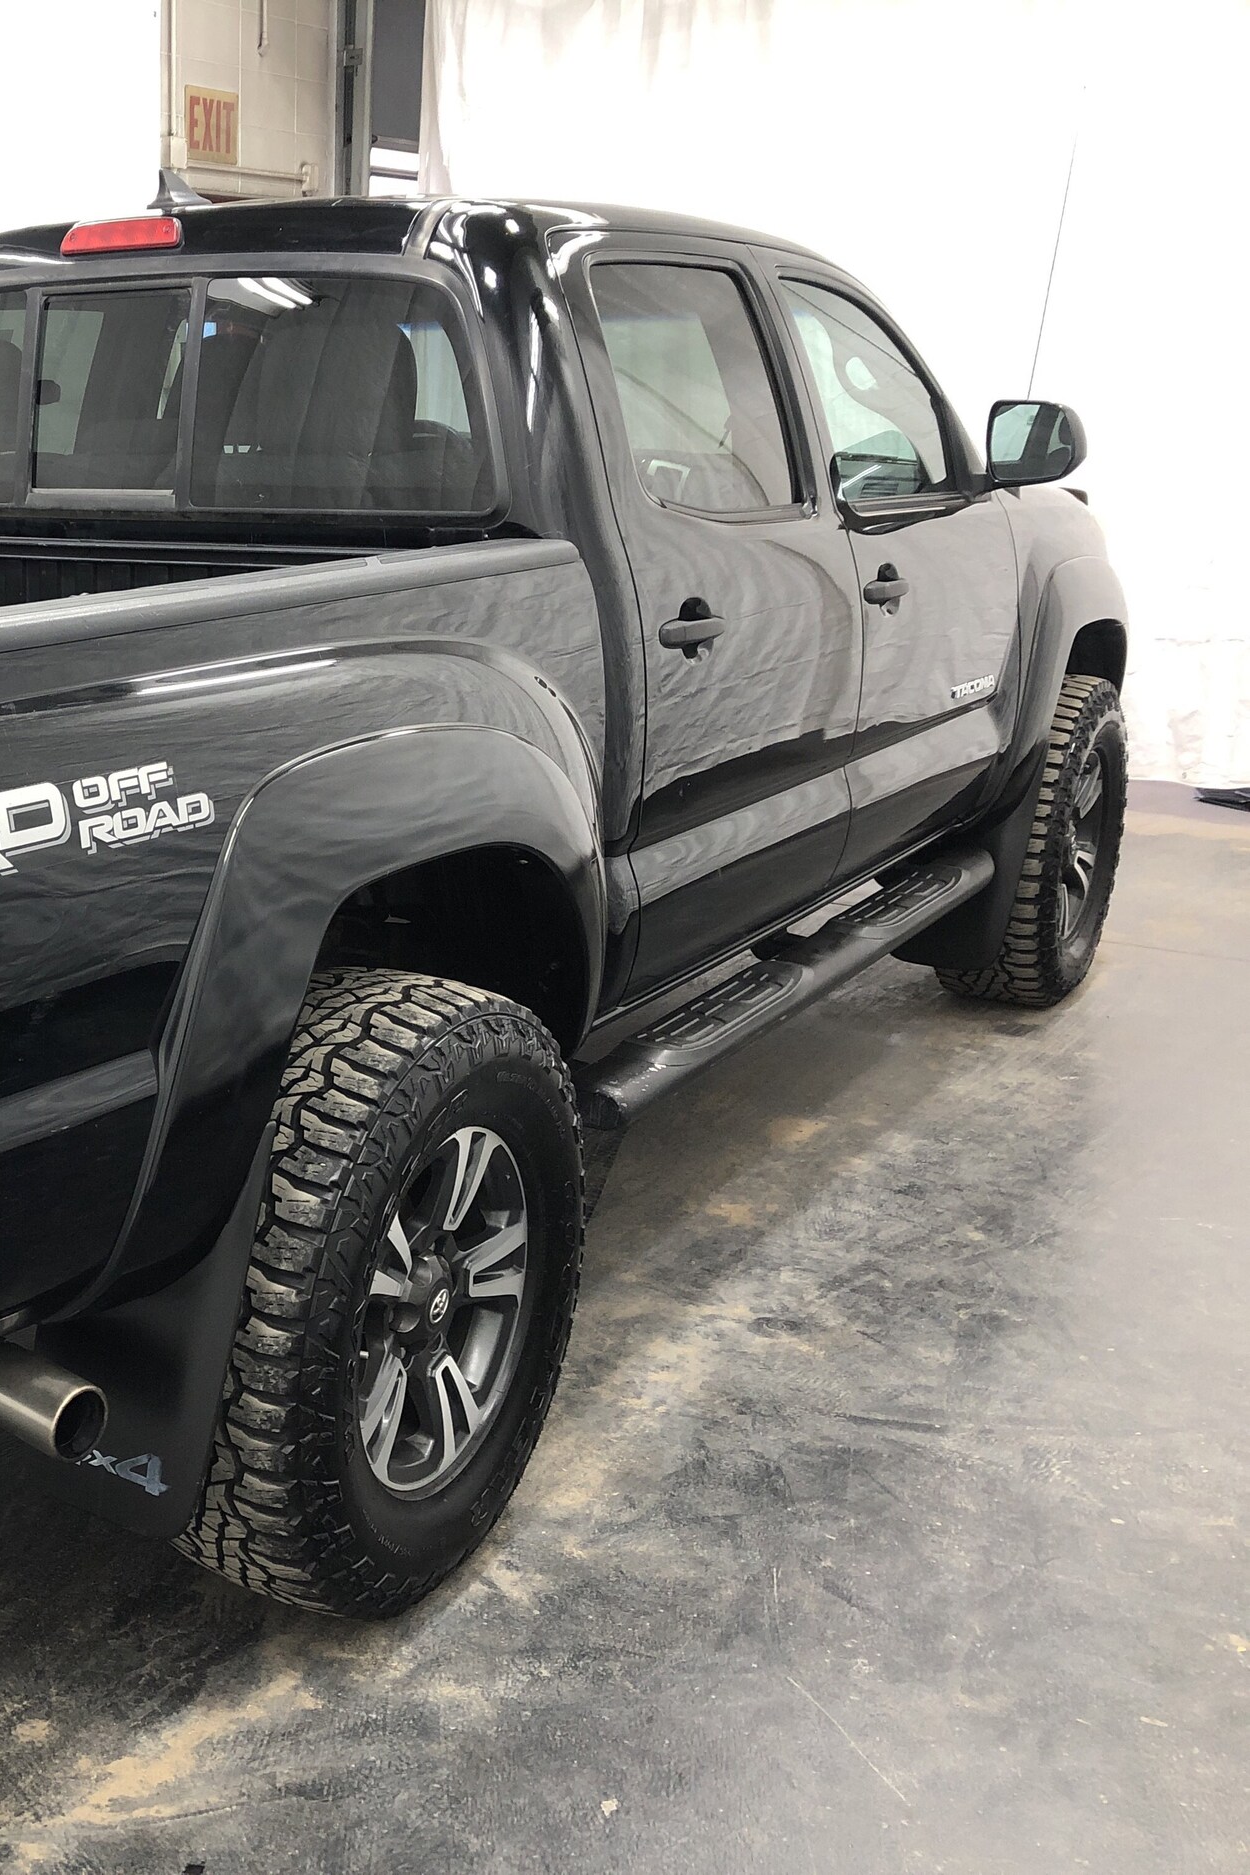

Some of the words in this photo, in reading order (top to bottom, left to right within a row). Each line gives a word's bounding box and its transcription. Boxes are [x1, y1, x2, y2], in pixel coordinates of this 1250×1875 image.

[189, 95, 234, 154] EXIT
[951, 675, 995, 698] TACOMA
[72, 761, 174, 813] OFF
[79, 792, 214, 855] ROAD
